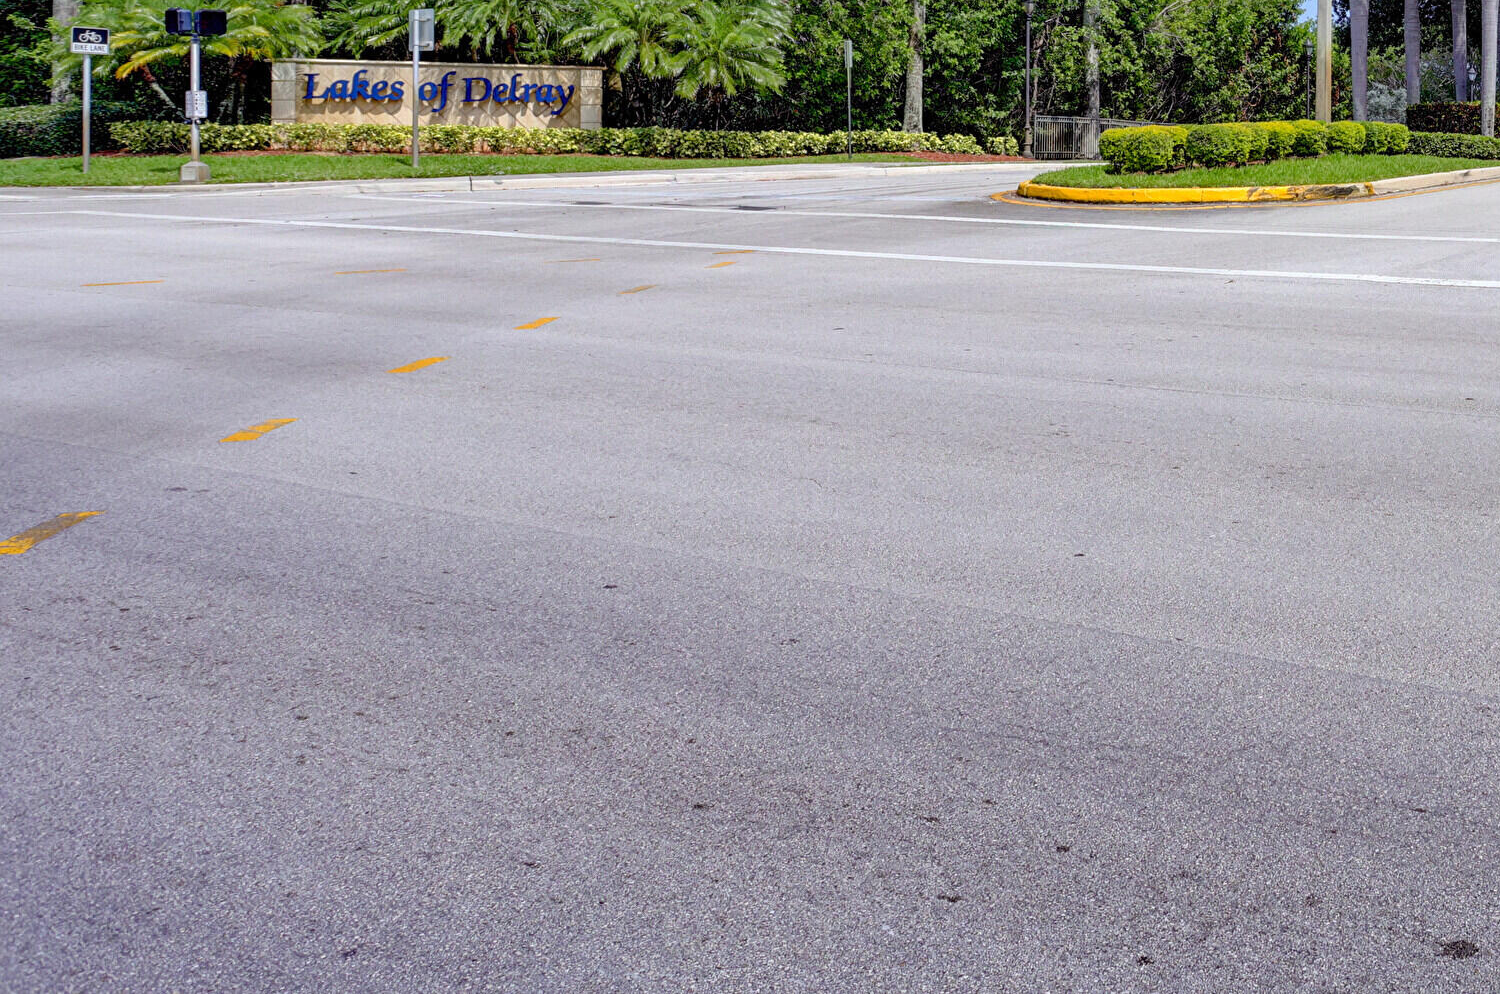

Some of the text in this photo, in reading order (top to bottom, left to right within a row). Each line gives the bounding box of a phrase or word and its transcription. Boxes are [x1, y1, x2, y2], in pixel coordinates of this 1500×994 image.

[90, 44, 105, 52] LANE
[302, 69, 575, 115] Lakes of Delray
